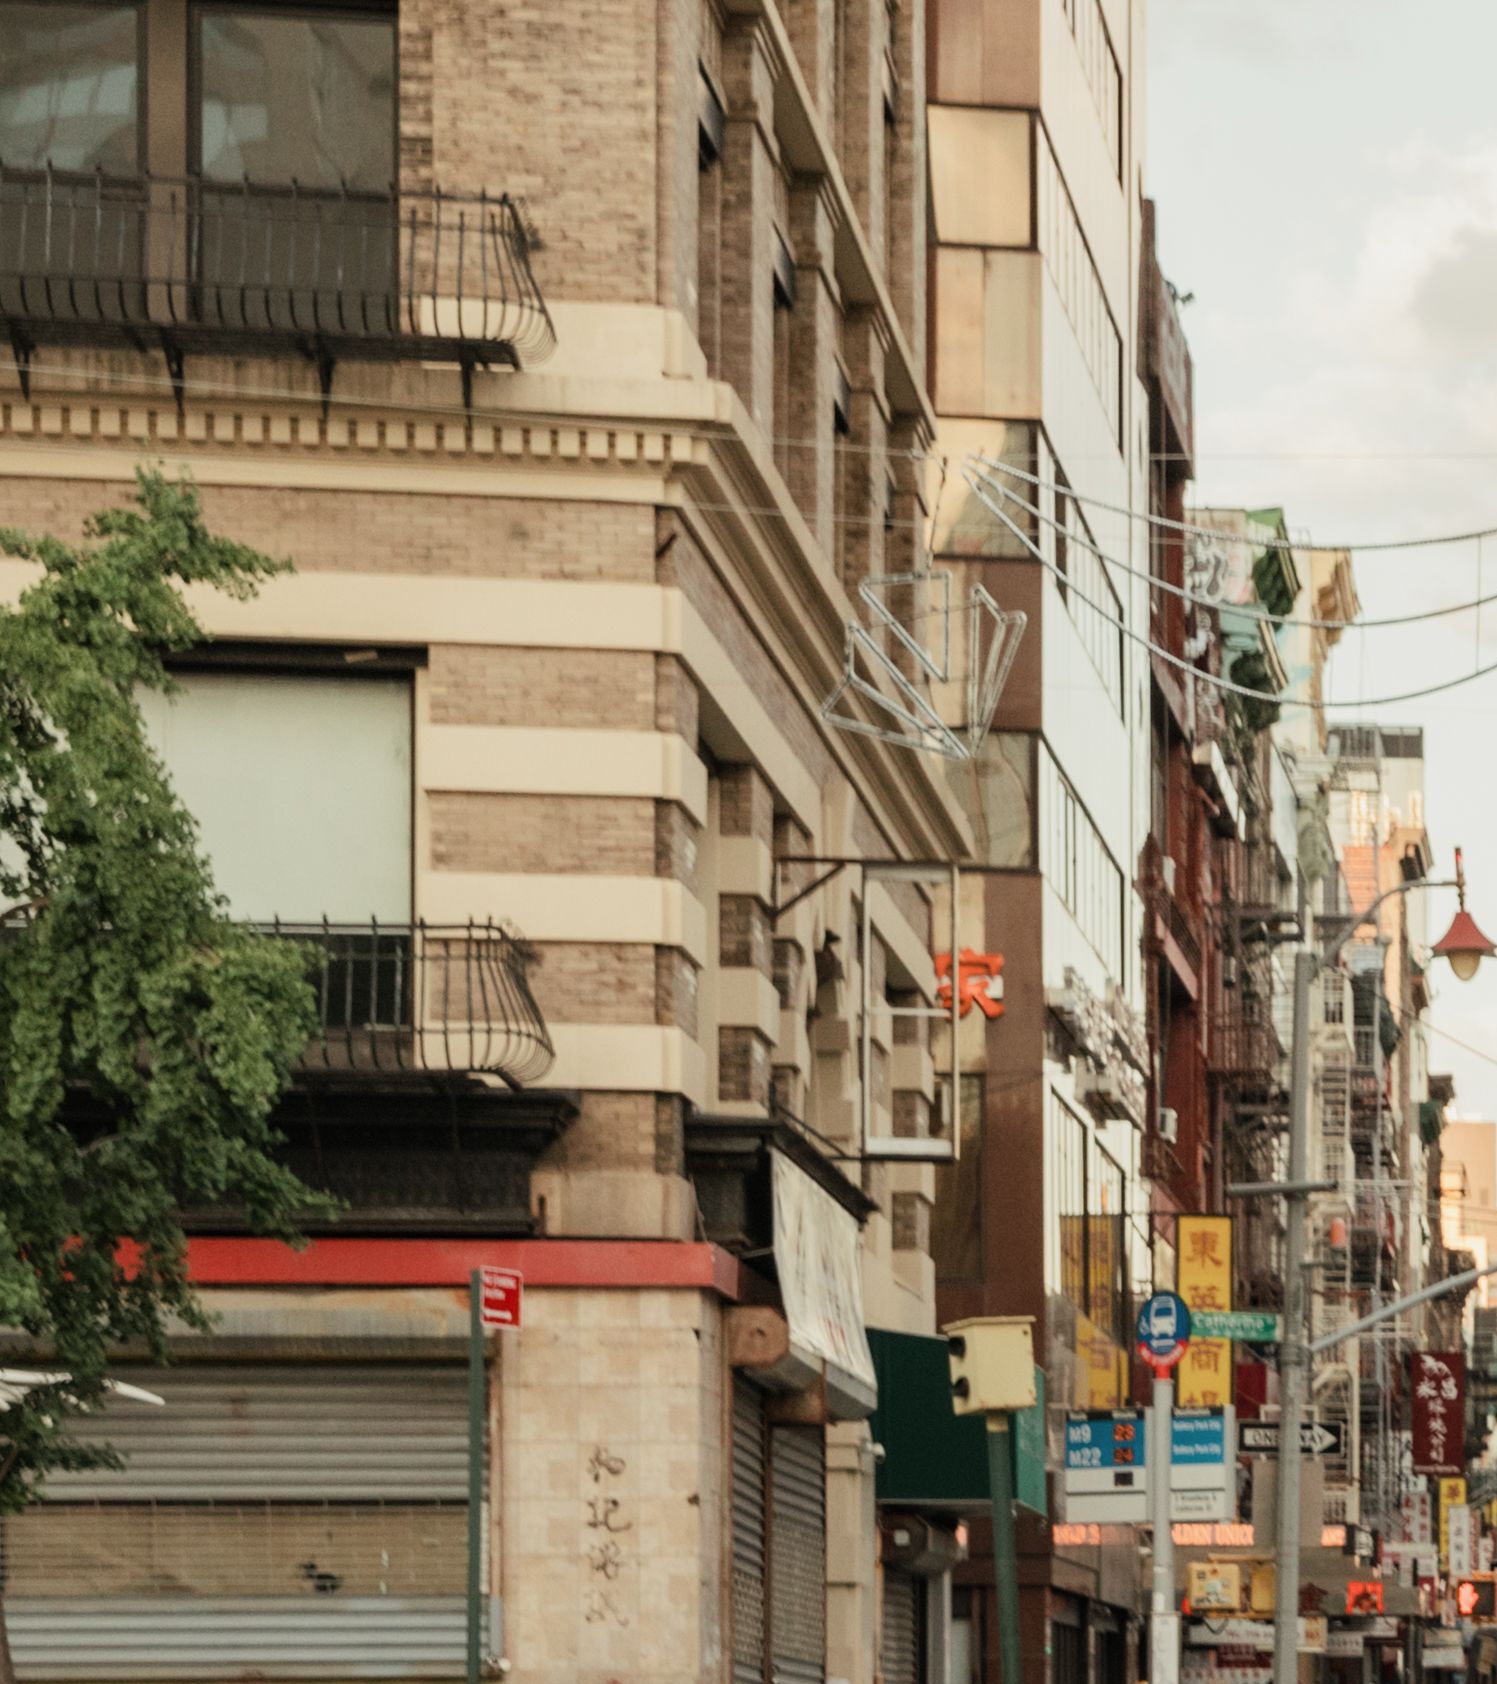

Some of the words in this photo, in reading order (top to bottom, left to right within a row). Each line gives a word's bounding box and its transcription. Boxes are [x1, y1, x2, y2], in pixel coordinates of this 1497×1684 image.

[1193, 1312, 1265, 1331] Catherine
[1069, 1424, 1092, 1443] M9
[1069, 1448, 1102, 1467] M22
